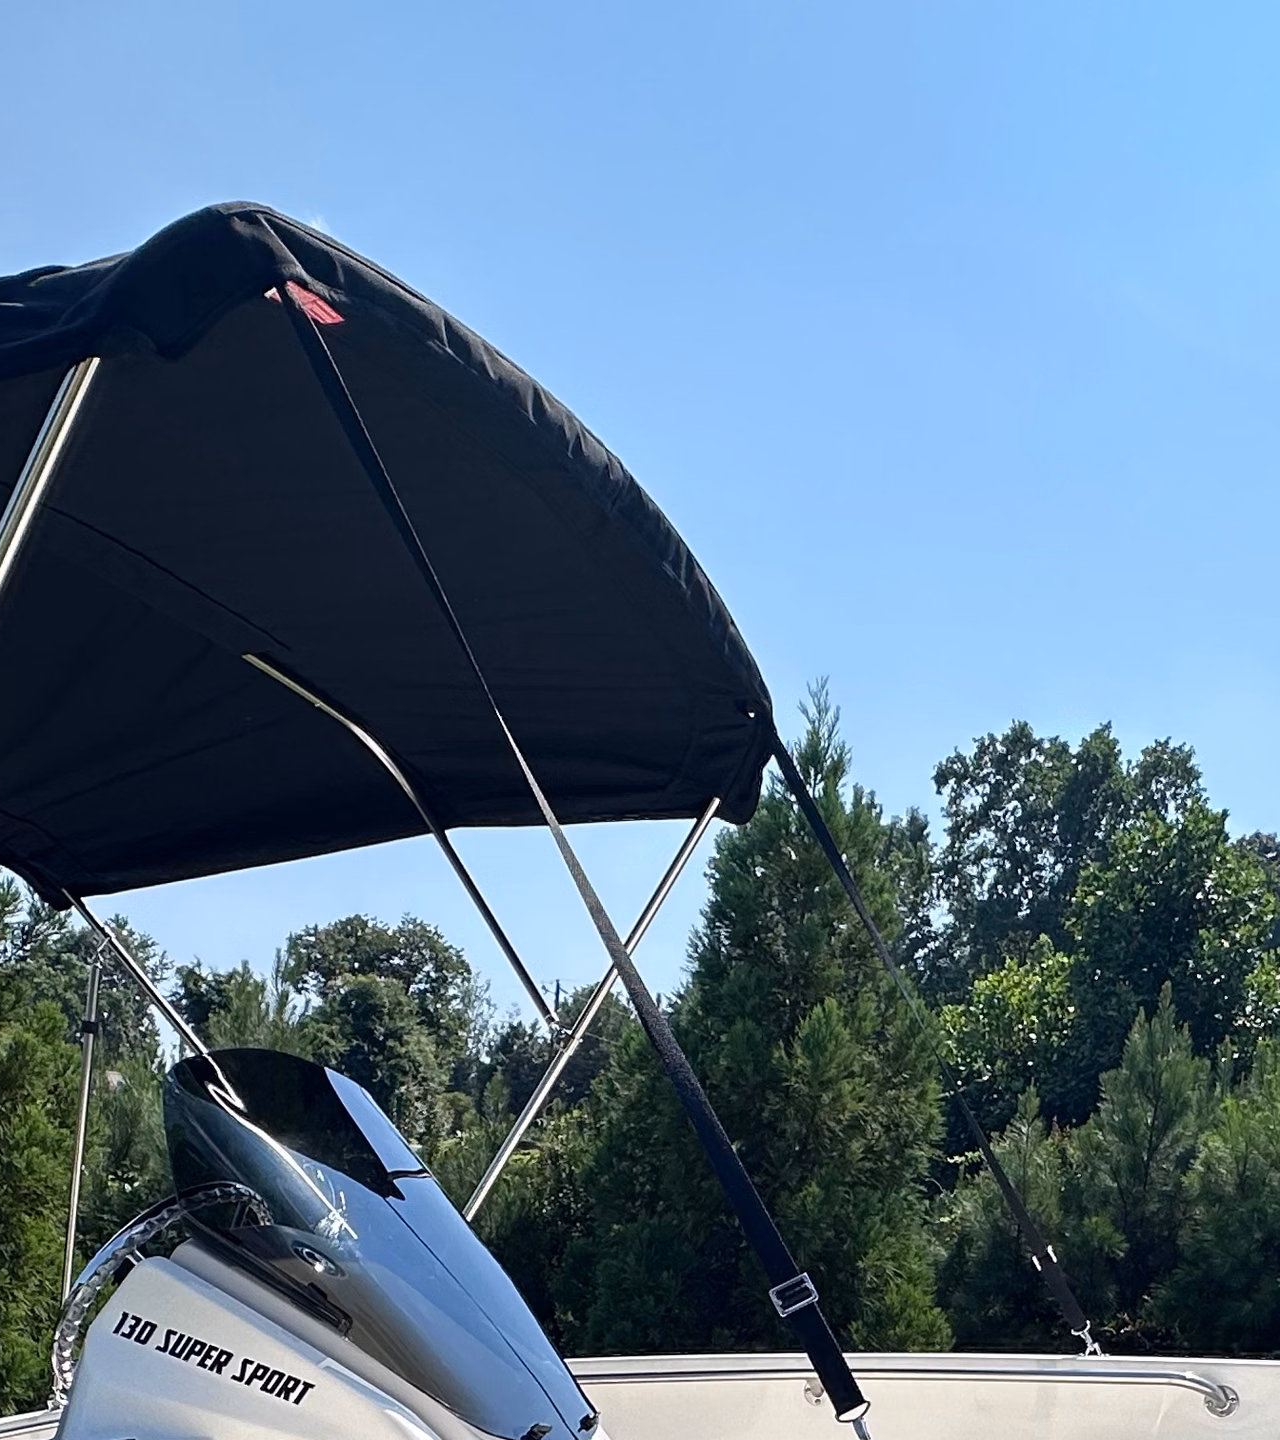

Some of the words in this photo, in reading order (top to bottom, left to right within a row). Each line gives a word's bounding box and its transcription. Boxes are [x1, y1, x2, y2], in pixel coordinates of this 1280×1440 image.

[112, 1311, 157, 1345] 130
[155, 1329, 233, 1375] SUPER
[231, 1358, 316, 1406] SPORT
